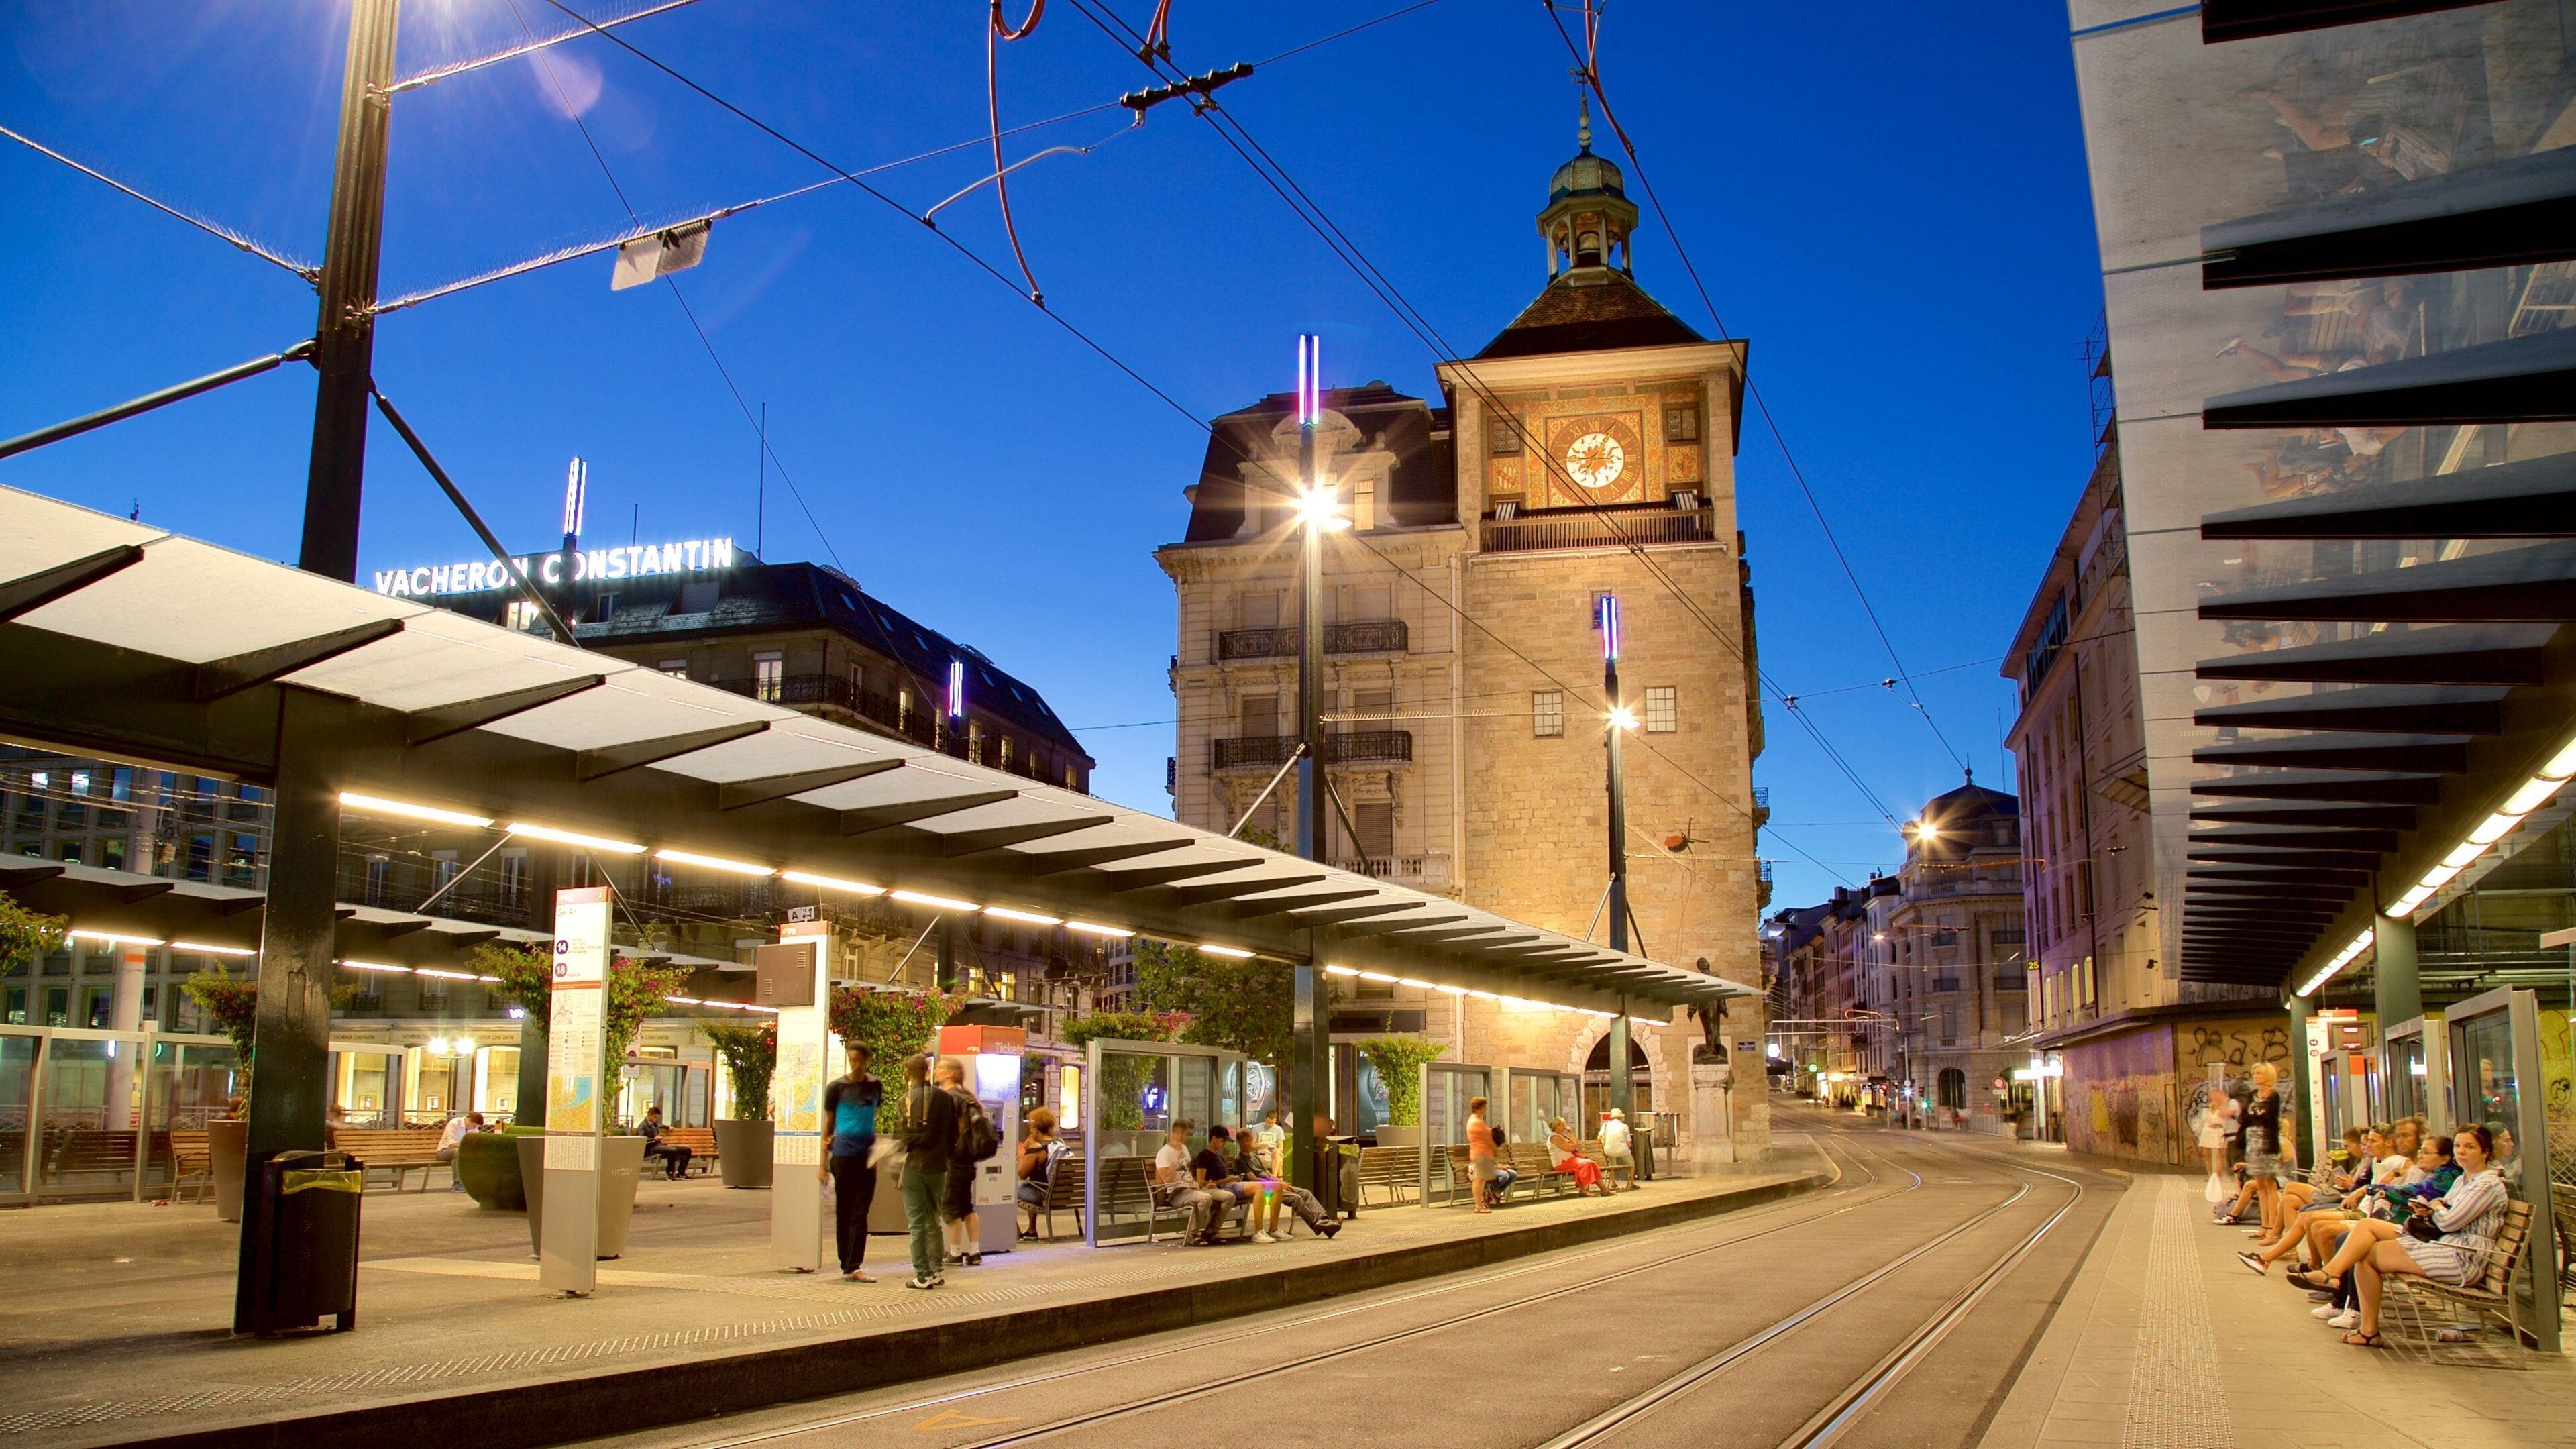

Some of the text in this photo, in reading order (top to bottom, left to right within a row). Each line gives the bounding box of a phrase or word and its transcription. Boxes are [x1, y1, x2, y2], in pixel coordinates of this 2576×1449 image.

[792, 911, 799, 920] A
[557, 942, 566, 952] 14
[556, 965, 566, 975] 18
[2028, 961, 2040, 970] 25
[995, 1042, 1025, 1055] Tickets
